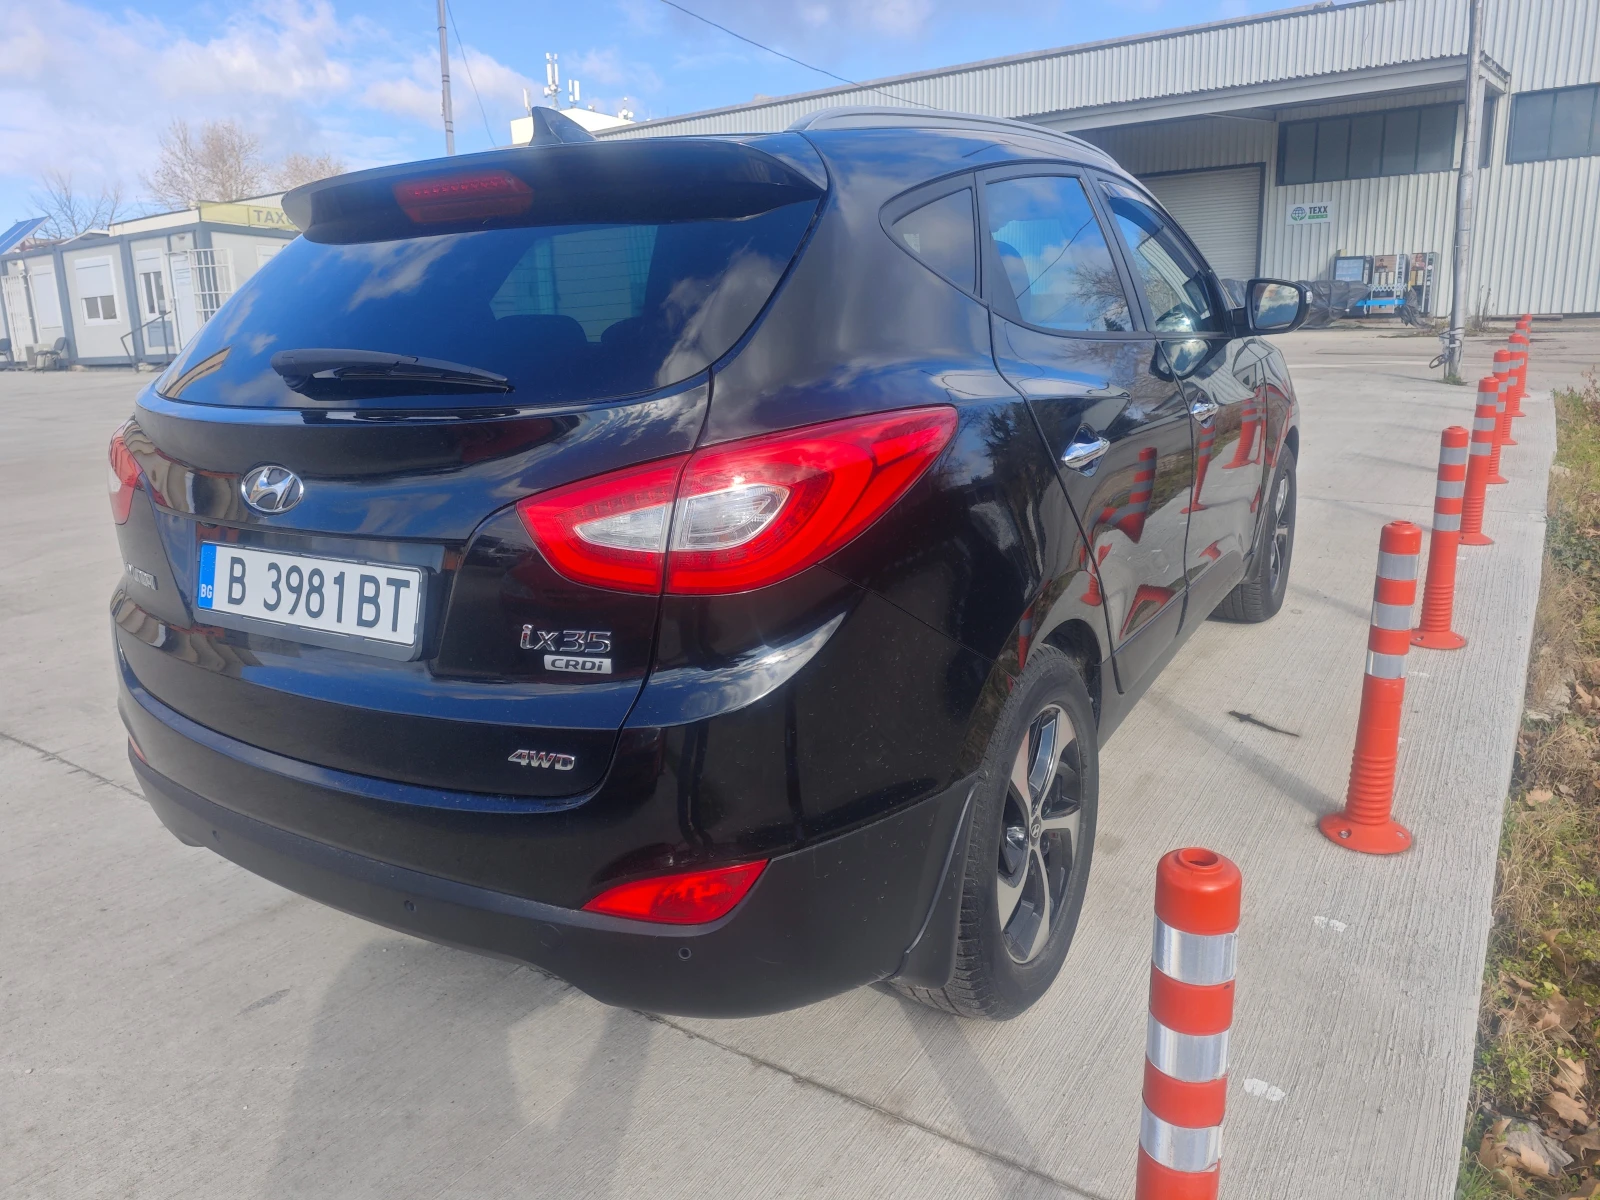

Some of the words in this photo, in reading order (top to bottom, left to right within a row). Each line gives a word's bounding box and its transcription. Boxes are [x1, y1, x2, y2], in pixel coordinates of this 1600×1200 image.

[1308, 205, 1328, 214] TEXX
[200, 583, 213, 599] BG
[228, 556, 246, 605] B
[263, 562, 411, 632] 3981BT
[520, 623, 612, 654] ix35
[550, 658, 603, 672] CRDi
[507, 749, 576, 771] 4WD
